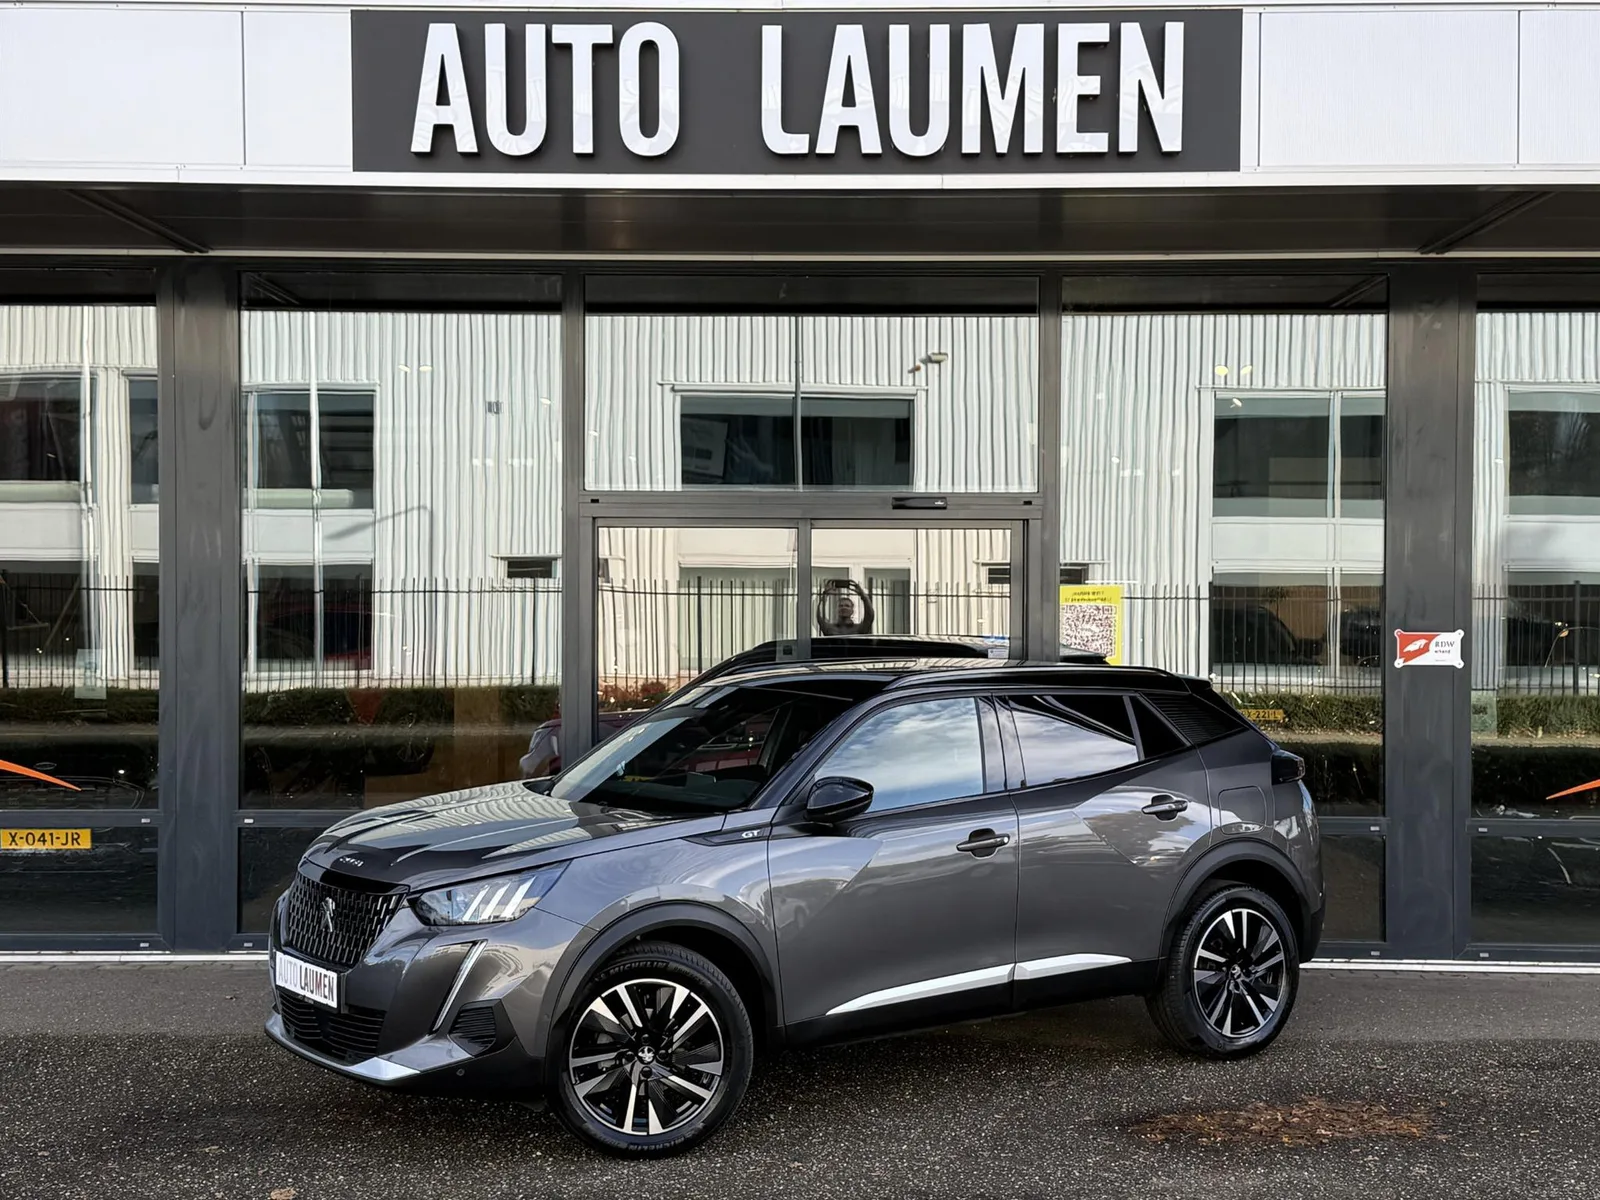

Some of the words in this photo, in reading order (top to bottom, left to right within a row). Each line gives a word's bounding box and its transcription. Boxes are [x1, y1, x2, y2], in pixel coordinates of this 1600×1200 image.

[410, 20, 681, 158] AUTO
[760, 20, 1186, 157] LAUMEN
[1434, 640, 1455, 648] RDW
[8, 832, 81, 846] X-041-JR
[741, 829, 761, 838] GT
[608, 960, 669, 976] MICHELIN
[278, 956, 298, 988] AUTO
[299, 964, 335, 1002] LAUMEN
